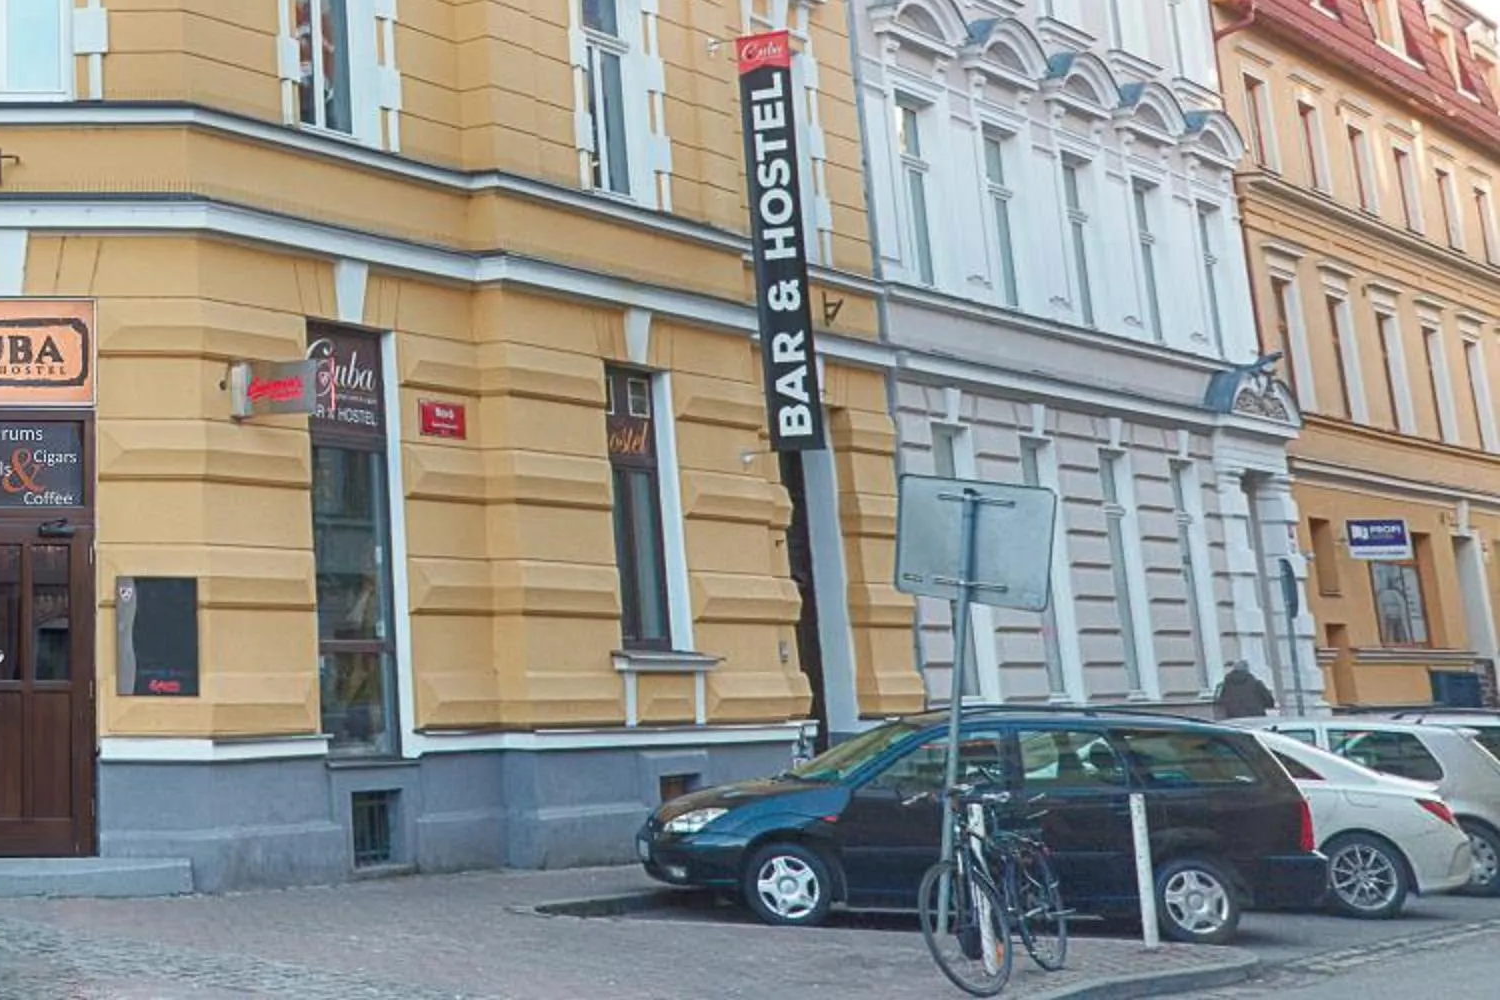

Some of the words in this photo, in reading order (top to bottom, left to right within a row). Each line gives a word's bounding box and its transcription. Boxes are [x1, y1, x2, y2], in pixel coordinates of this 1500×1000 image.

[752, 71, 797, 261] HOSTEL
[768, 279, 801, 312] &
[772, 329, 813, 438] BAR
[1, 429, 43, 441] rums
[3, 447, 46, 493] &
[33, 450, 77, 466] Cigars
[23, 491, 74, 505] Coffee
